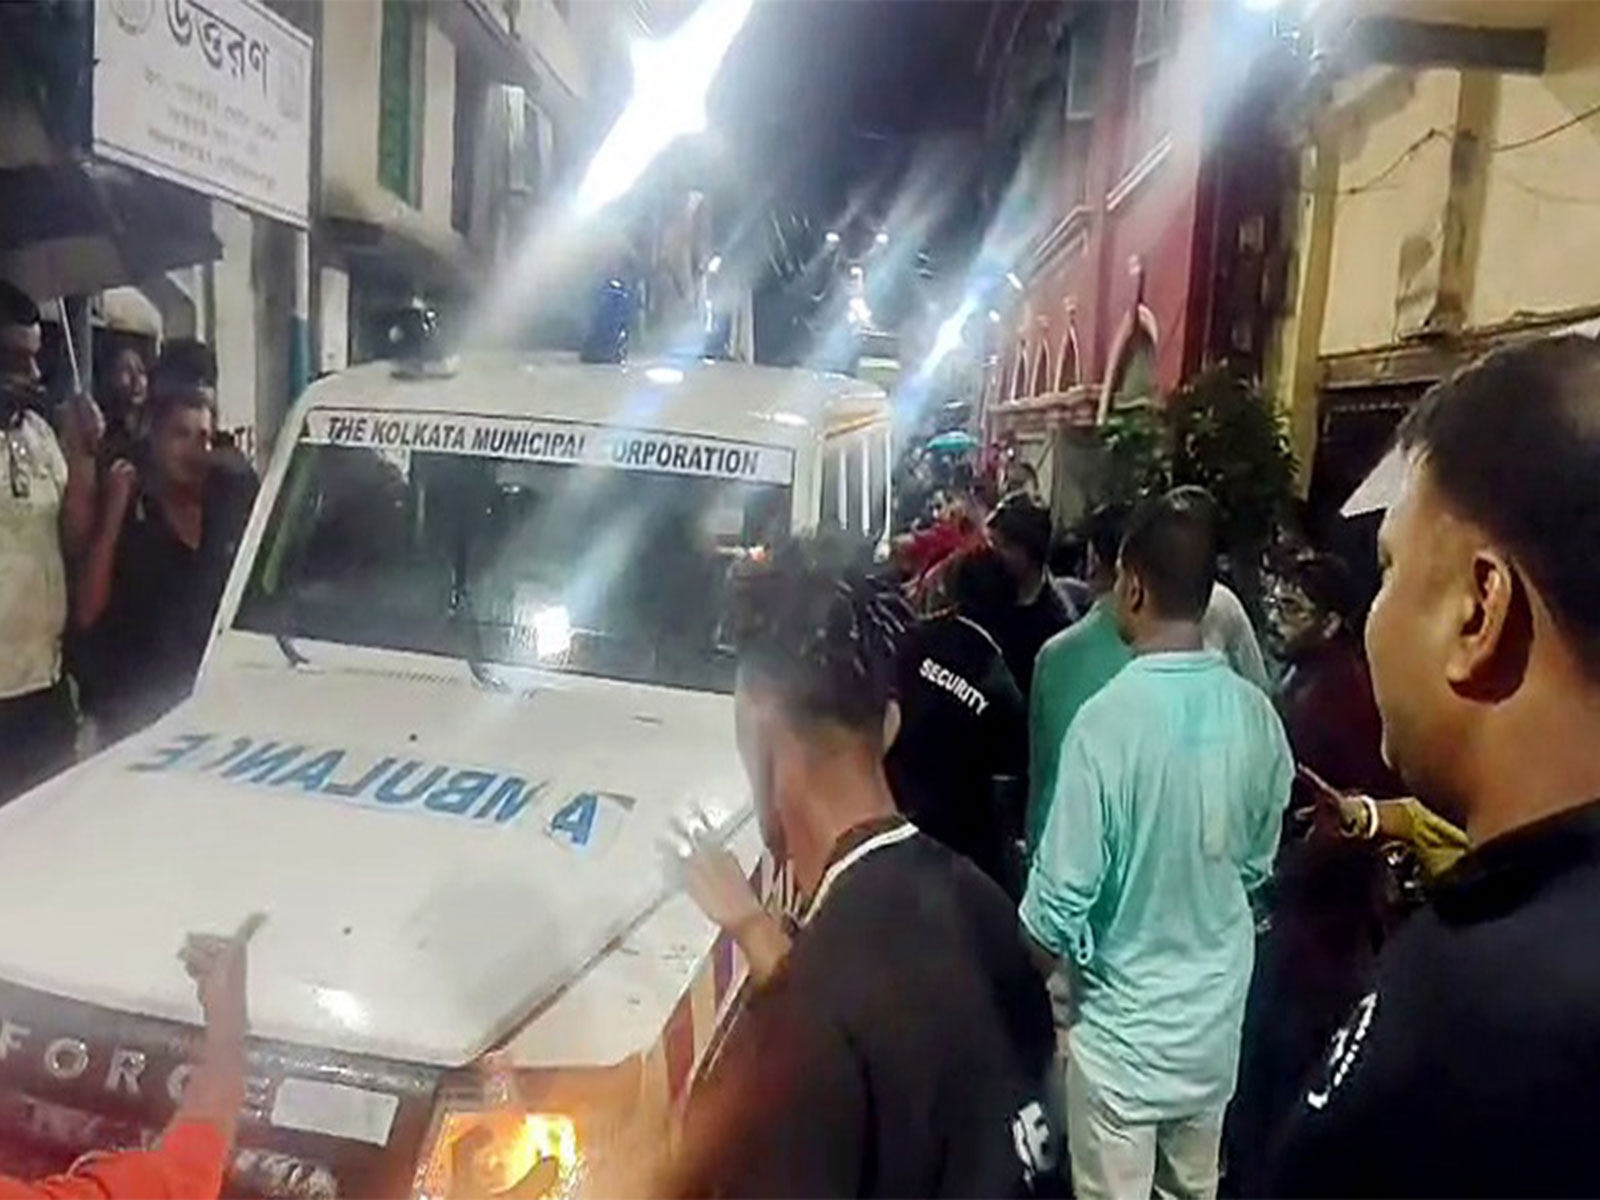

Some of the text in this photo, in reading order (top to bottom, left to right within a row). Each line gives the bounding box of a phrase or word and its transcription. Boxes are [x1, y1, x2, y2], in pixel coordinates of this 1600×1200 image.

[327, 416, 367, 442] THE
[370, 416, 466, 450] KOLKATA
[610, 438, 759, 475] ORPORATION
[919, 657, 989, 715] SECURITY
